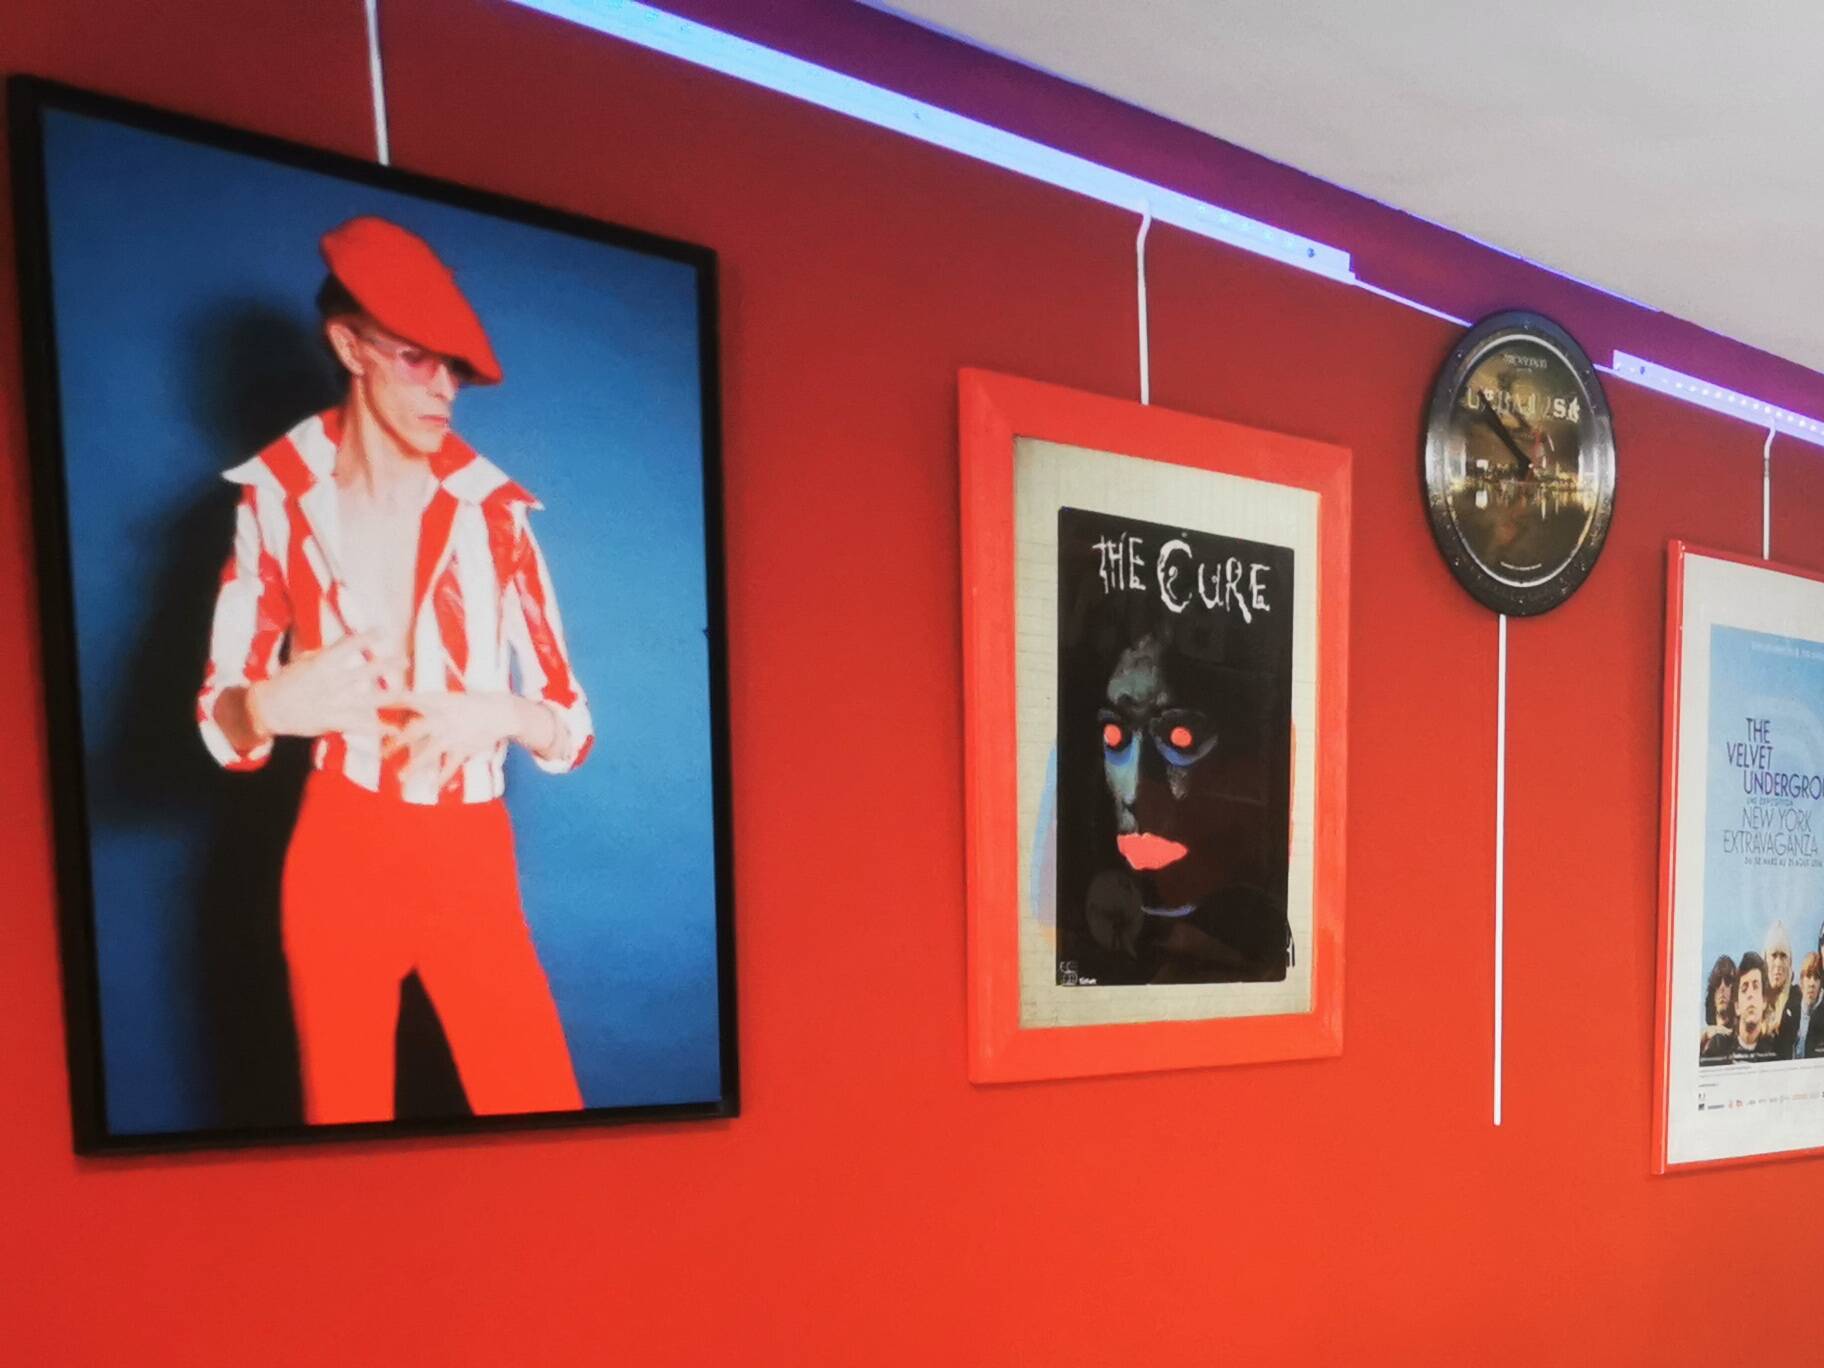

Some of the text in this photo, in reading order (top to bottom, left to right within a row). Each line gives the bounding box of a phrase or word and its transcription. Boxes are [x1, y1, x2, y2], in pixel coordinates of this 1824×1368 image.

[1092, 533, 1271, 624] THE CURE
[1745, 718, 1771, 744] THE
[1726, 742, 1774, 771] VELVET
[1742, 807, 1812, 833] NEW YORK
[1723, 830, 1818, 857] EXTRAVAGANZA
